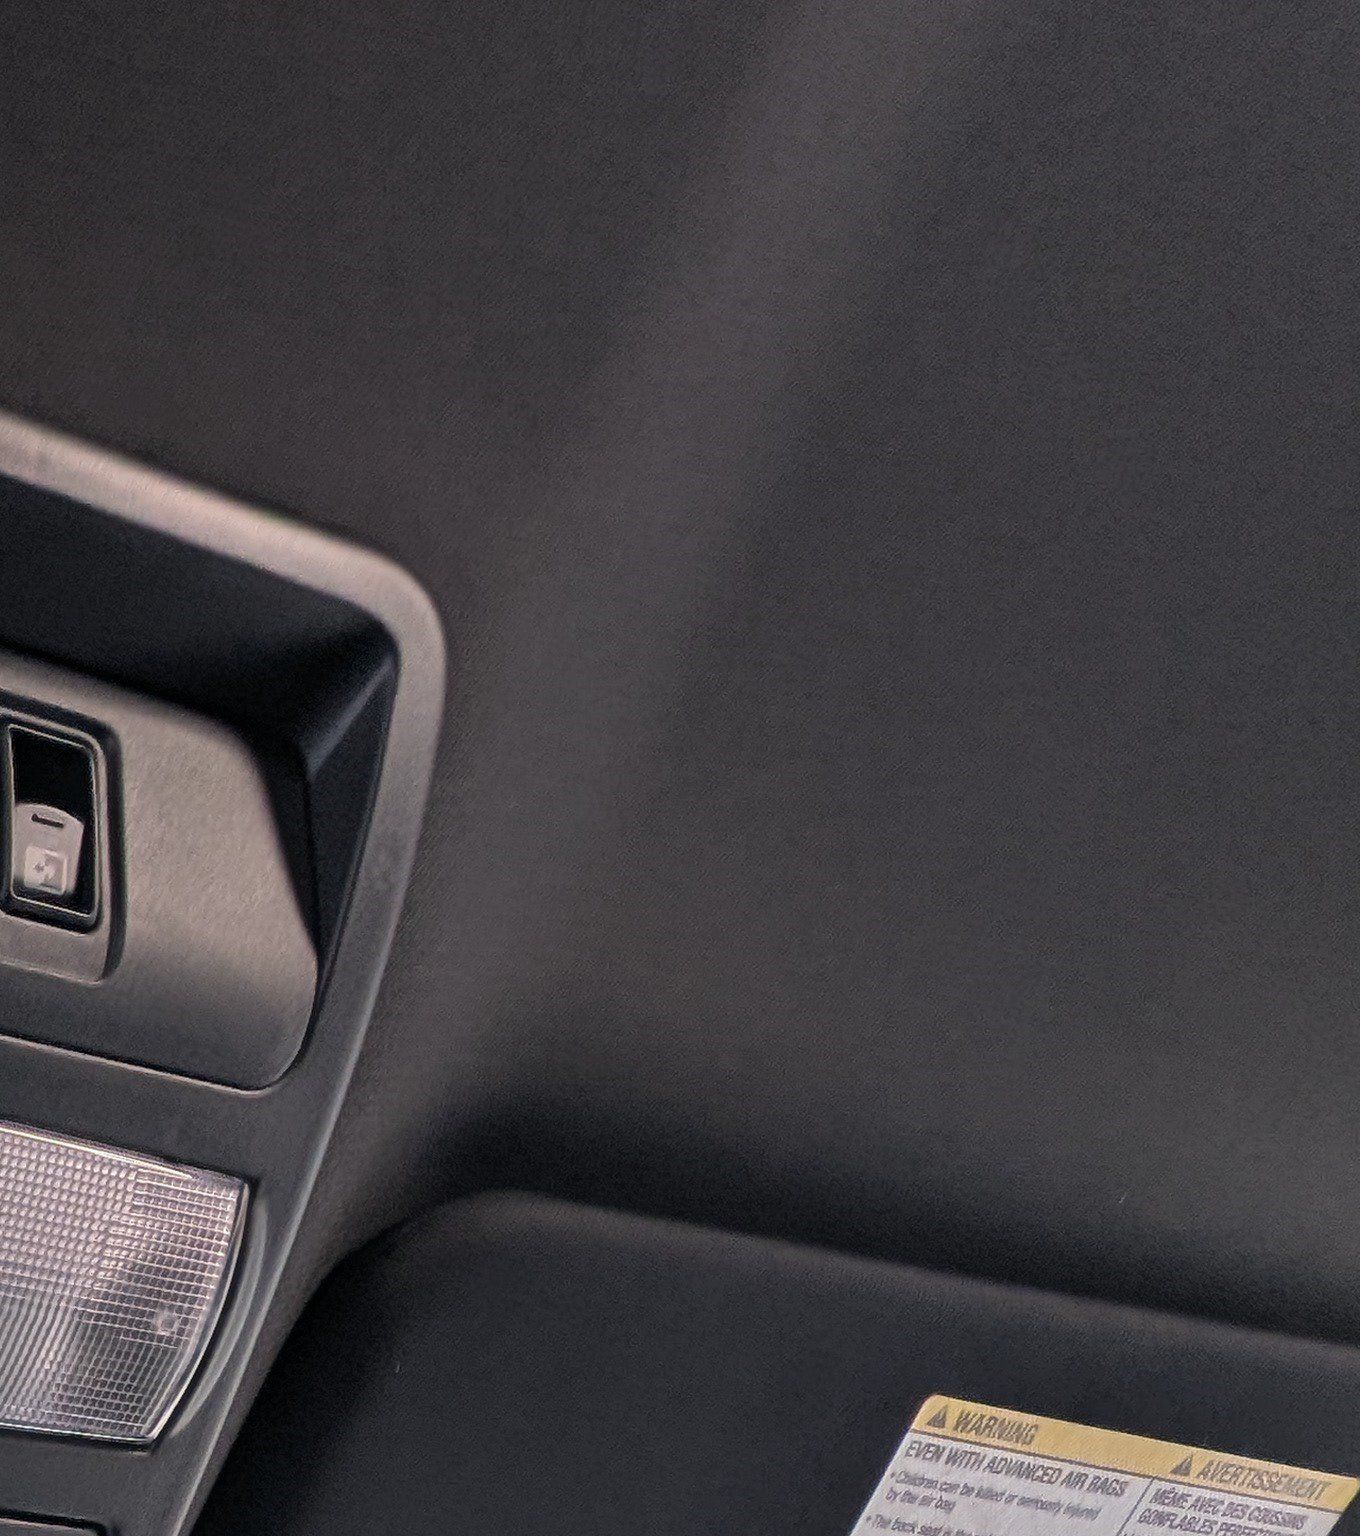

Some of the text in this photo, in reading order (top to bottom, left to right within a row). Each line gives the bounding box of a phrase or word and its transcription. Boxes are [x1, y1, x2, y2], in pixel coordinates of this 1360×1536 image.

[954, 1408, 1039, 1447] WARNING
[905, 1440, 944, 1465] EVEN
[944, 1448, 985, 1472] WITH
[985, 1456, 1062, 1486] ADVANCED
[1196, 1459, 1332, 1500] AVERTISSEMENT
